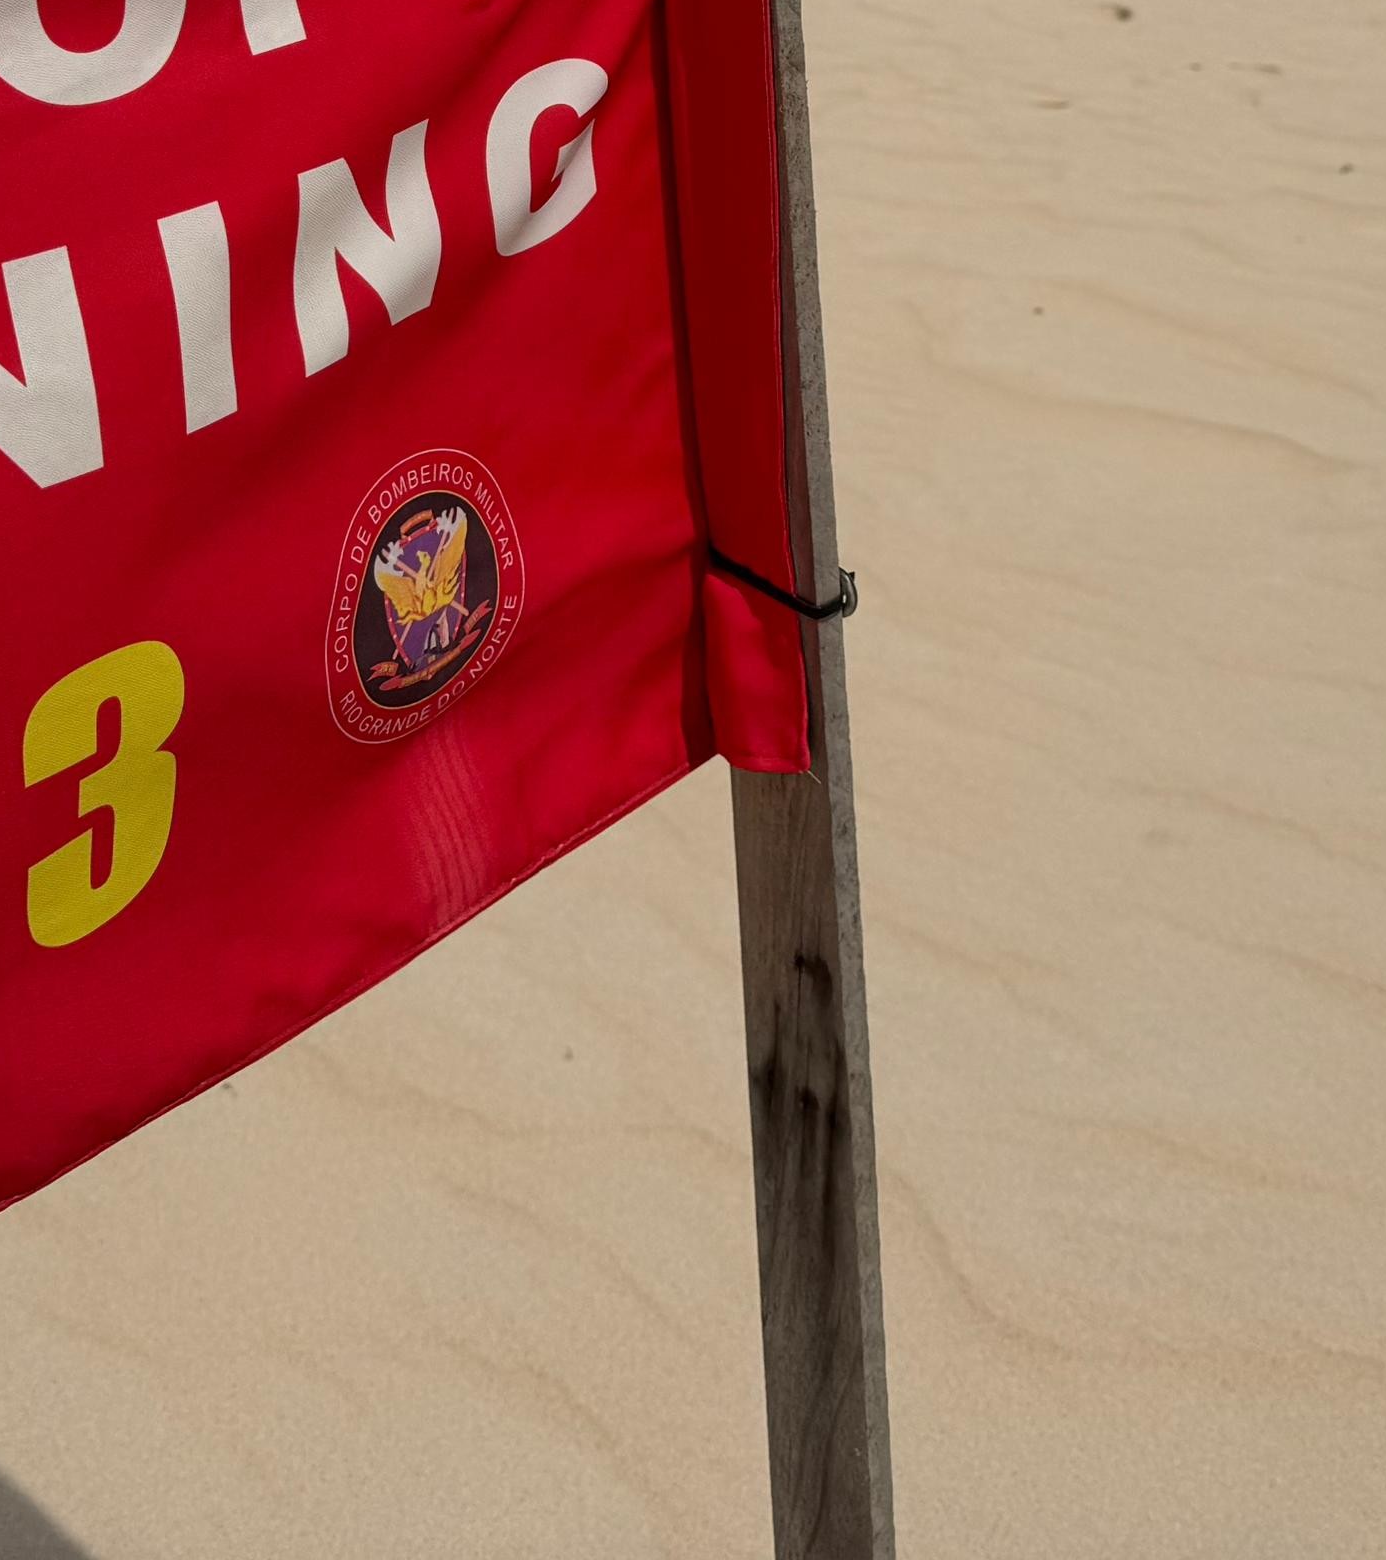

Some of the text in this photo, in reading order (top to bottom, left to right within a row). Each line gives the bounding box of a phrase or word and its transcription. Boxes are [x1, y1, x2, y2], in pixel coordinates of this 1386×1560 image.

[333, 572, 359, 673] CORPO
[350, 526, 372, 565] DE
[367, 462, 474, 523] BOMBEIROS
[474, 481, 514, 571] MILITAR
[339, 689, 363, 724] RIO
[358, 704, 431, 737] GRANDE
[437, 679, 466, 711] DO
[469, 594, 518, 680] NORTE
